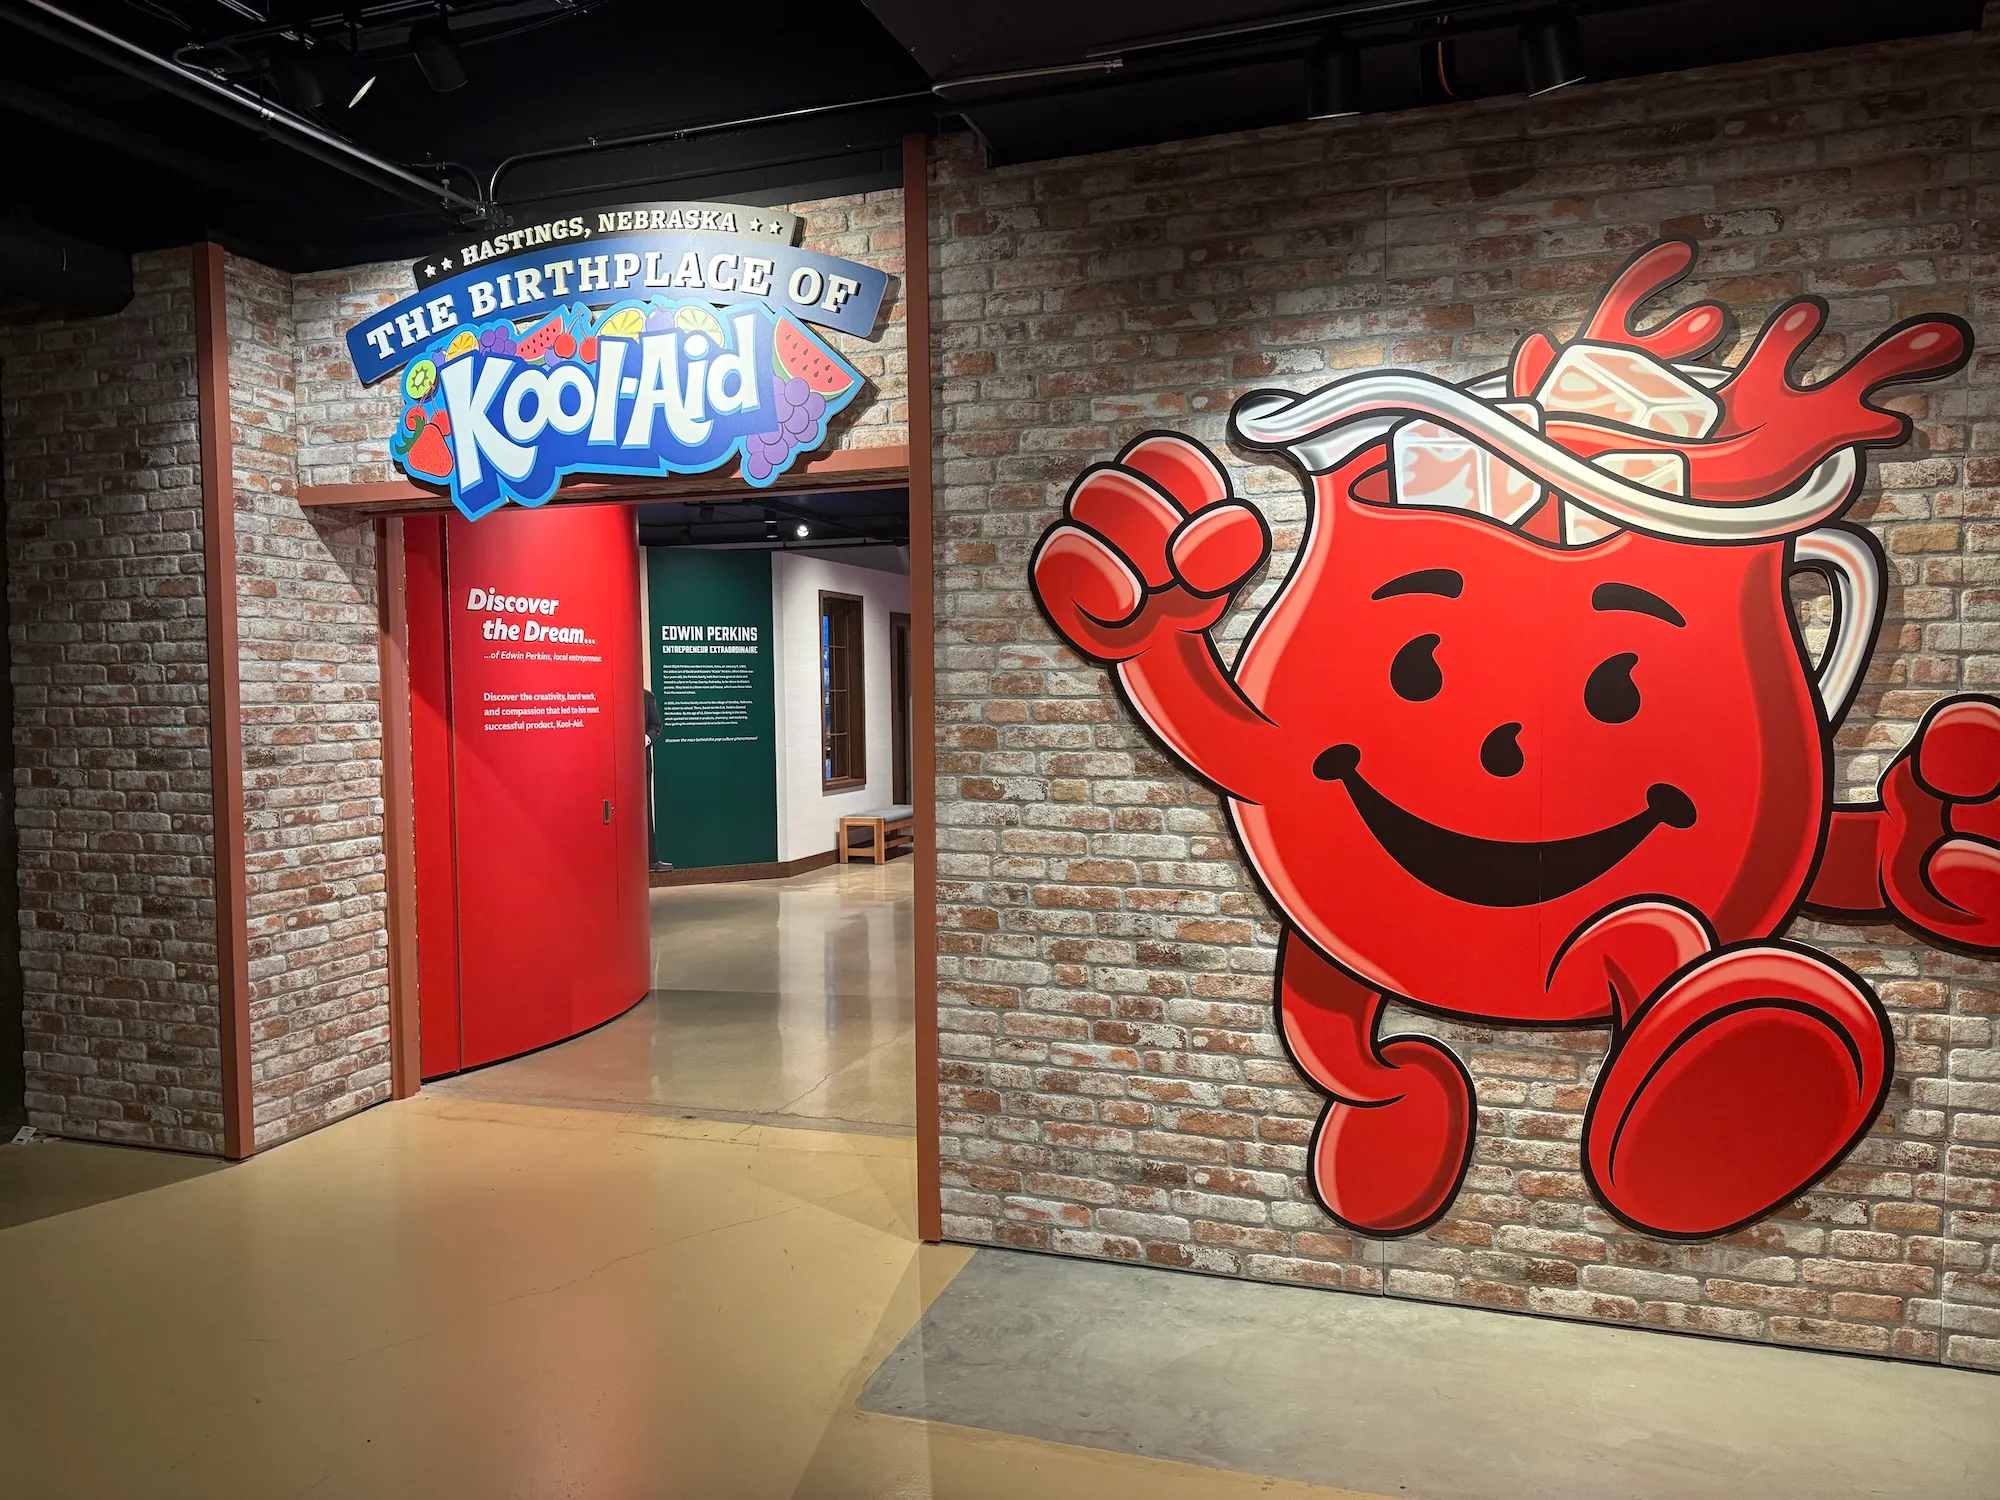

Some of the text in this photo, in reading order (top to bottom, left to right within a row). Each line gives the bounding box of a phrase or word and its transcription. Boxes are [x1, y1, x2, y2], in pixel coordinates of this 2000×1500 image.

[460, 209, 737, 266] HASTINGS, NEBRASKA
[366, 250, 859, 360] THE BIRTHPLACE OF
[439, 313, 760, 488] Kool-Aid
[467, 587, 559, 615] Discover
[482, 618, 596, 645] the Dream...
[662, 626, 758, 641] EDWIN PERKINS
[501, 651, 524, 660] Edwin
[525, 652, 552, 662] Perkins,
[554, 652, 568, 661] local
[662, 646, 758, 654] ENTREPRENEUR EXTRAORDINAIRE
[484, 692, 518, 701] Discover
[520, 692, 532, 700] the
[534, 692, 566, 702] creativity,
[567, 692, 580, 700] hard
[484, 707, 500, 716] and
[502, 706, 545, 717] compassion
[546, 706, 560, 714] that
[561, 706, 570, 714] led
[578, 706, 586, 714] his
[484, 720, 584, 731] successful product, Kool-Aid.
